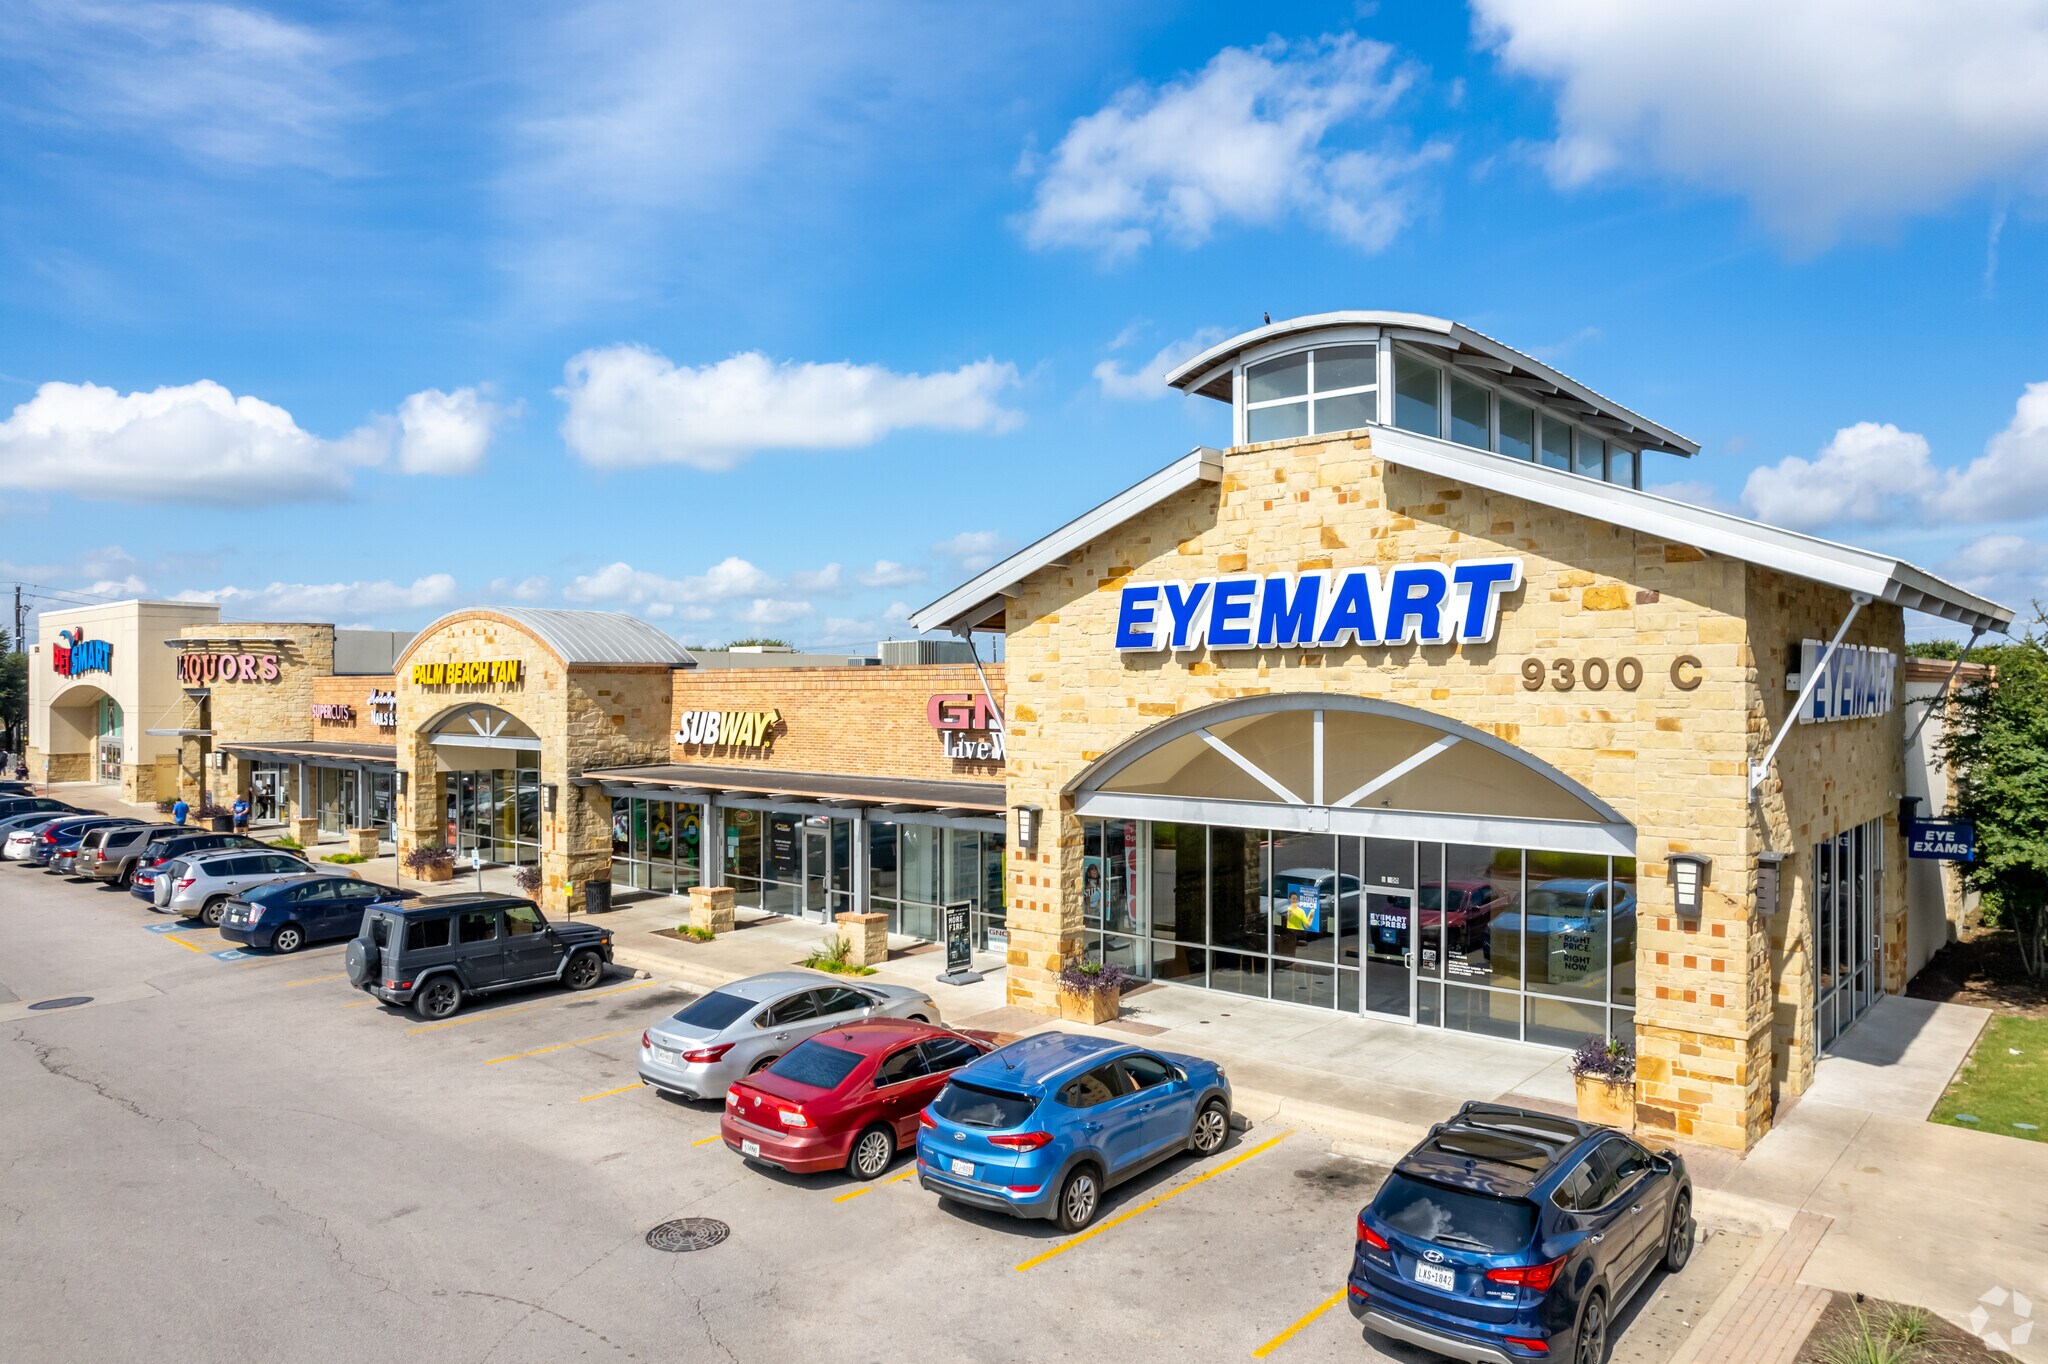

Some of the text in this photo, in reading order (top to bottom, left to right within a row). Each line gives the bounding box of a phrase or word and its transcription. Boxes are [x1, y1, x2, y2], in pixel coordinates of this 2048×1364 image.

[1115, 557, 1522, 652] EYEMART
[177, 654, 279, 686] LIQUORS
[413, 660, 519, 685] PALM BEACH TAN
[1521, 655, 1702, 690] 9300 C
[1799, 638, 1898, 724] EYEMART
[312, 704, 350, 720] SUPERCUTS
[674, 708, 779, 747] SUBWAY
[1925, 830, 1956, 842] EYE
[1913, 841, 1968, 854] EXAMS
[948, 915, 963, 925] MORE
[1370, 912, 1407, 923] EYEMART
[1370, 919, 1407, 930] EXPRESS
[1564, 935, 1591, 945] RIGHT
[1564, 954, 1591, 965] RIGHT
[1565, 962, 1590, 973] NOW.
